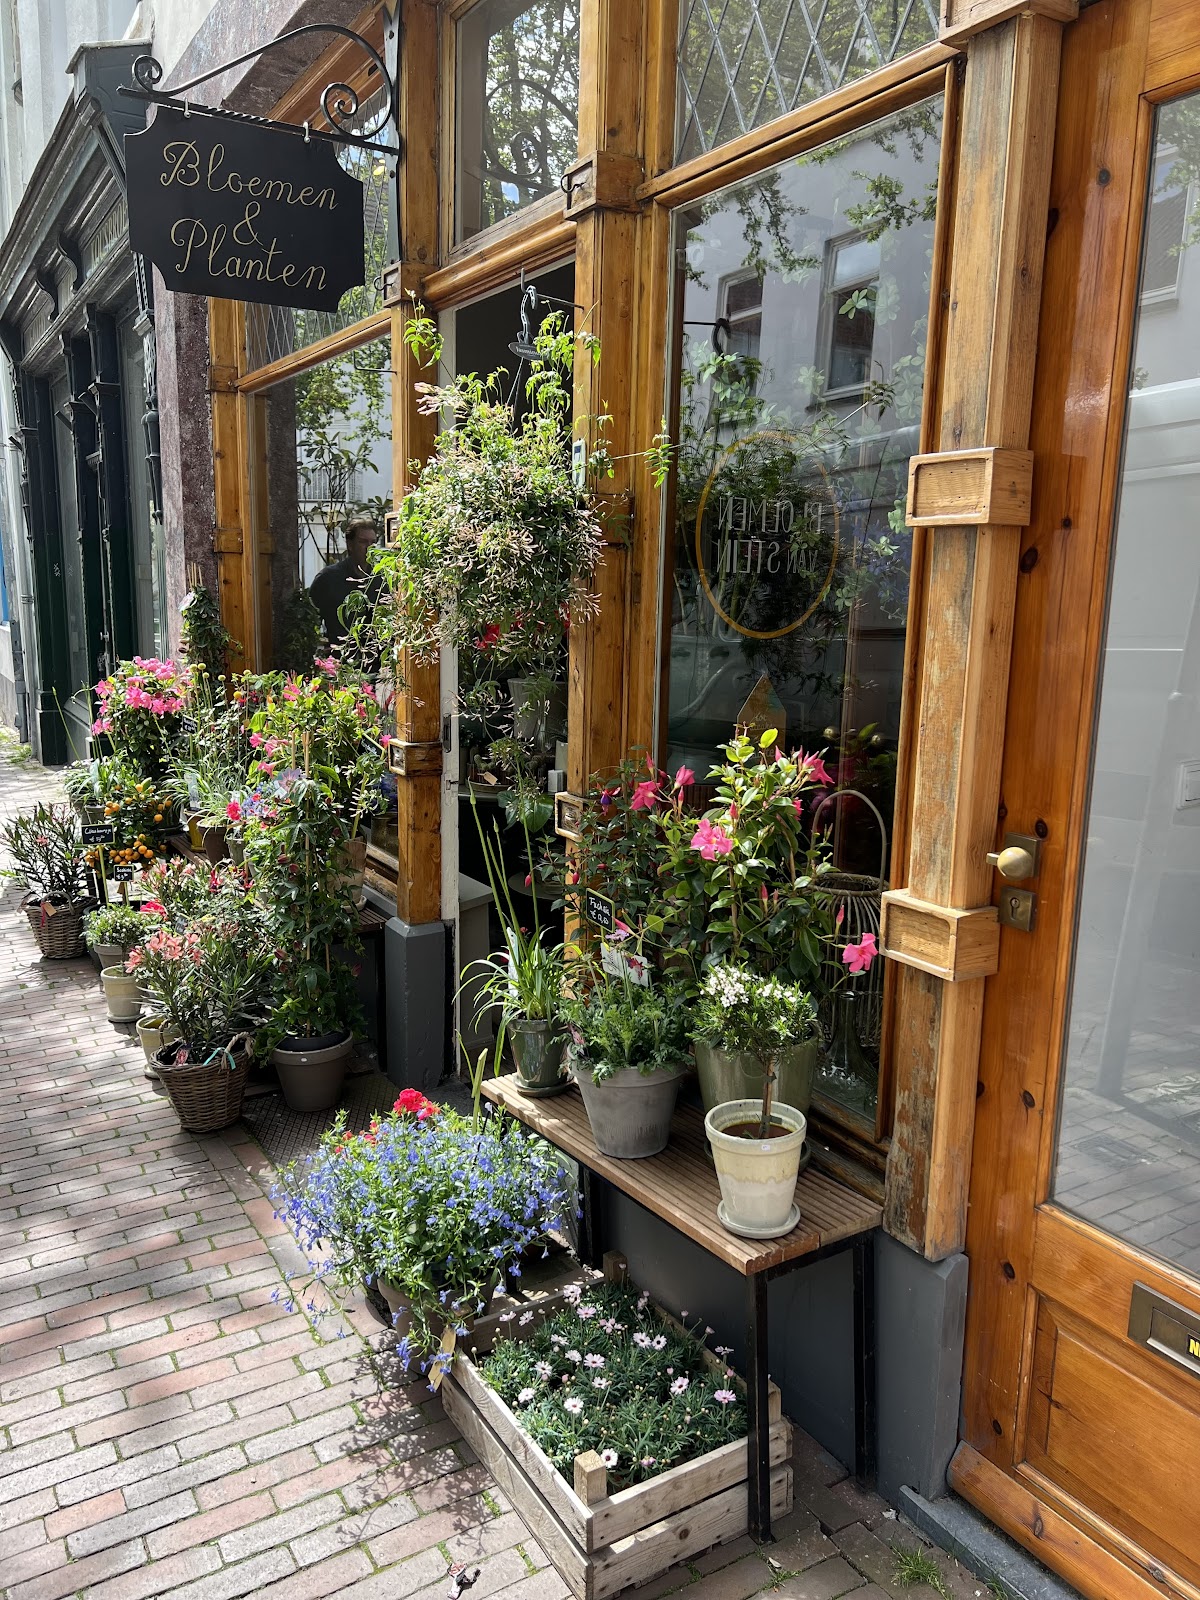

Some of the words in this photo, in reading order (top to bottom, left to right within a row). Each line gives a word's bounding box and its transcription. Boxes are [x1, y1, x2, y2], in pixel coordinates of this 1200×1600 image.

[159, 140, 338, 210] Bloemen
[170, 217, 328, 290] Planten
[232, 201, 264, 246] &
